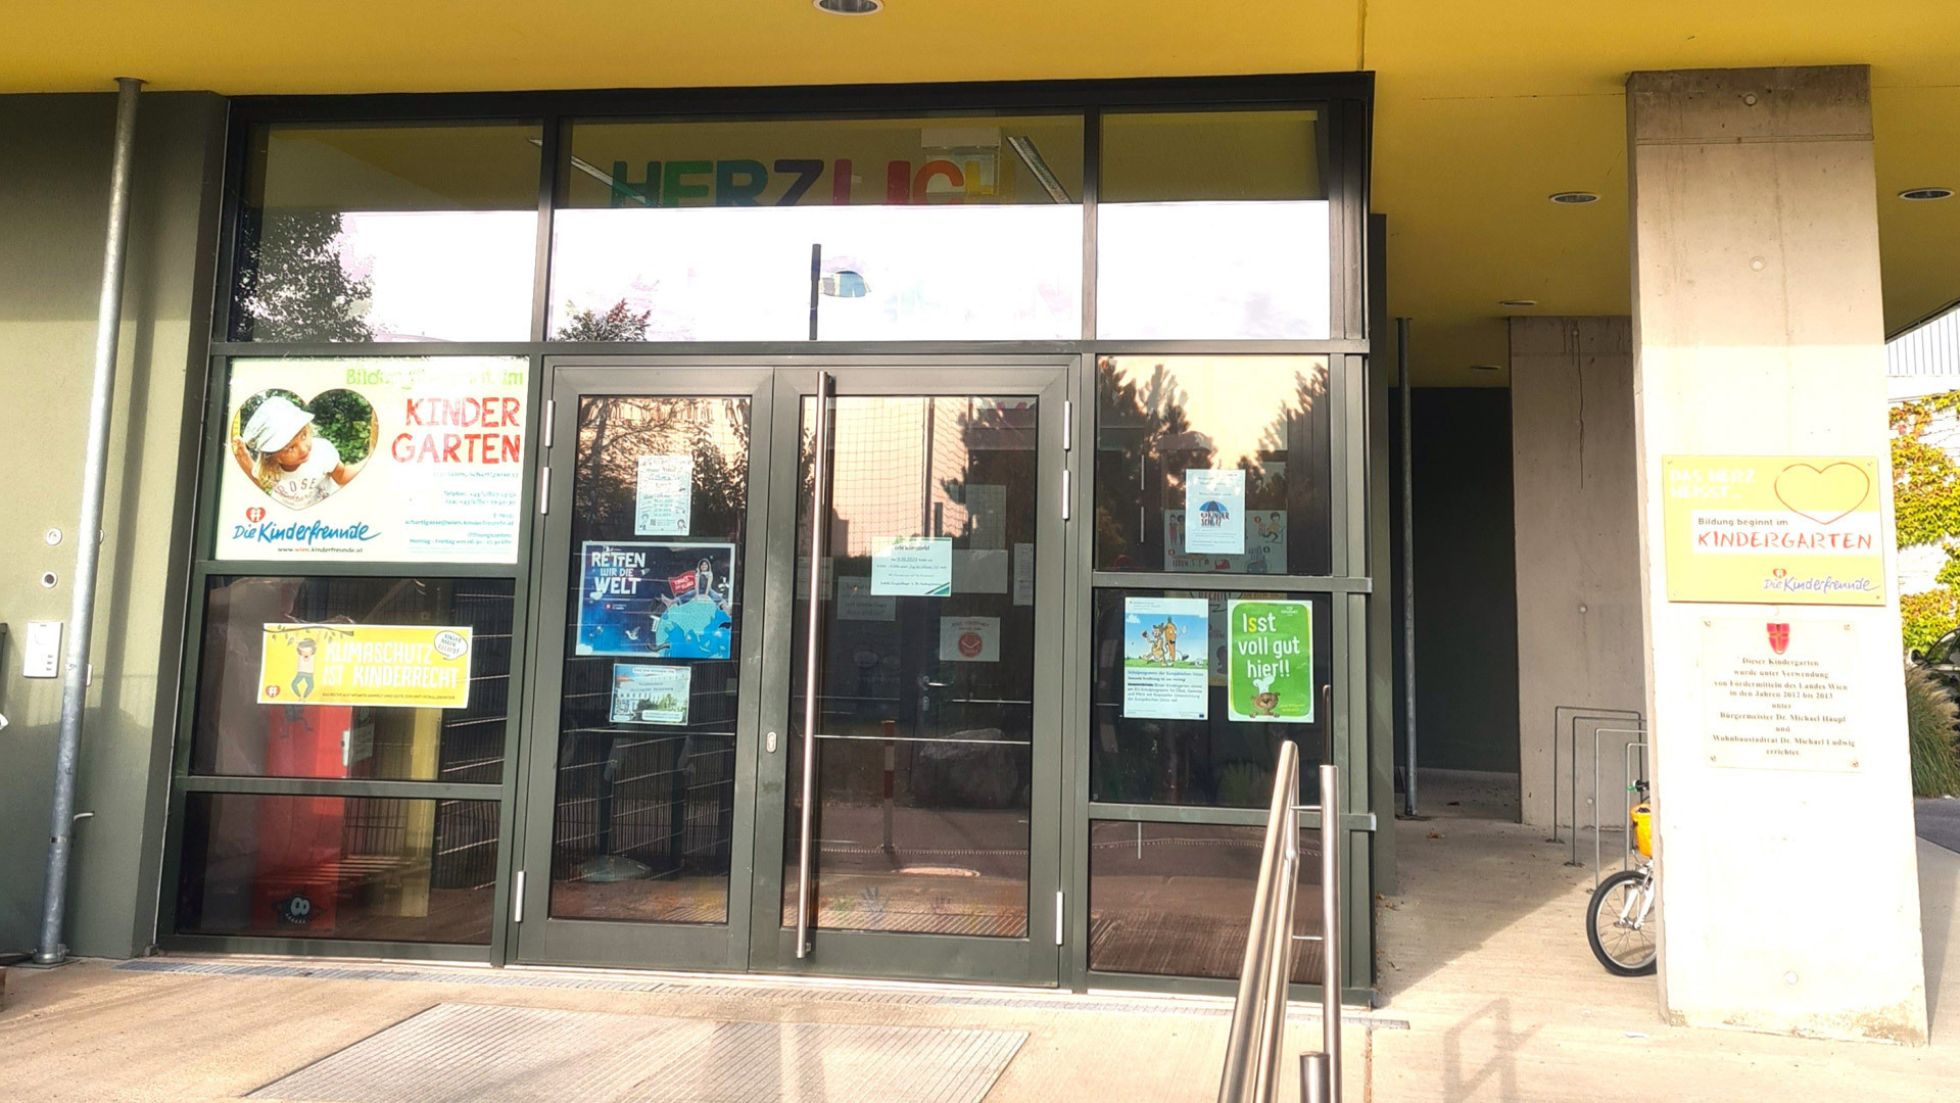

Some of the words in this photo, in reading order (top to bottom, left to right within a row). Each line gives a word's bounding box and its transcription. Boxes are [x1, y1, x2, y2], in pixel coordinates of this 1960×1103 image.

[405, 397, 521, 428] KINDER
[391, 432, 521, 464] GARTEN
[1698, 517, 1735, 527] Bildung
[1737, 518, 1773, 528] beginnt
[1776, 518, 1789, 527] im
[232, 523, 257, 539] Die
[257, 519, 382, 545] Kinderfreunde
[1697, 530, 1873, 550] KINDERGARTEN
[591, 551, 647, 568] RETTEN
[599, 567, 618, 577] WIR
[619, 567, 635, 577] DIE
[594, 577, 642, 595] WELT
[1763, 577, 1784, 590] Die
[1783, 576, 1880, 594] Kinderfreunde
[1242, 612, 1277, 633] Isst
[326, 641, 433, 666] KLIMASCHUTZ
[1238, 635, 1269, 655] voll
[1272, 635, 1301, 659] gut
[1247, 659, 1291, 679] hier!!
[1742, 656, 1766, 665] Dieser
[1768, 657, 1819, 667] Kindergarten
[321, 664, 346, 686] IST
[351, 665, 460, 689] KINDERRECHT
[1734, 669, 1757, 677] wurde
[1781, 670, 1830, 680] Verwendung
[1729, 689, 1738, 697] in
[1739, 689, 1753, 698] den
[1754, 690, 1781, 698] Jahren
[1803, 691, 1814, 699] bis
[1784, 681, 1797, 690] des
[1798, 682, 1826, 691] Landes
[1828, 683, 1848, 691] Wien
[1771, 702, 1792, 710] unter
[1719, 711, 1773, 721] Bürgermeister
[1776, 713, 1787, 721] Dr.
[1790, 713, 1820, 722] Michael
[1780, 736, 1792, 745] Dr.
[1794, 737, 1825, 746] Michael
[1826, 738, 1856, 748] Ludwig
